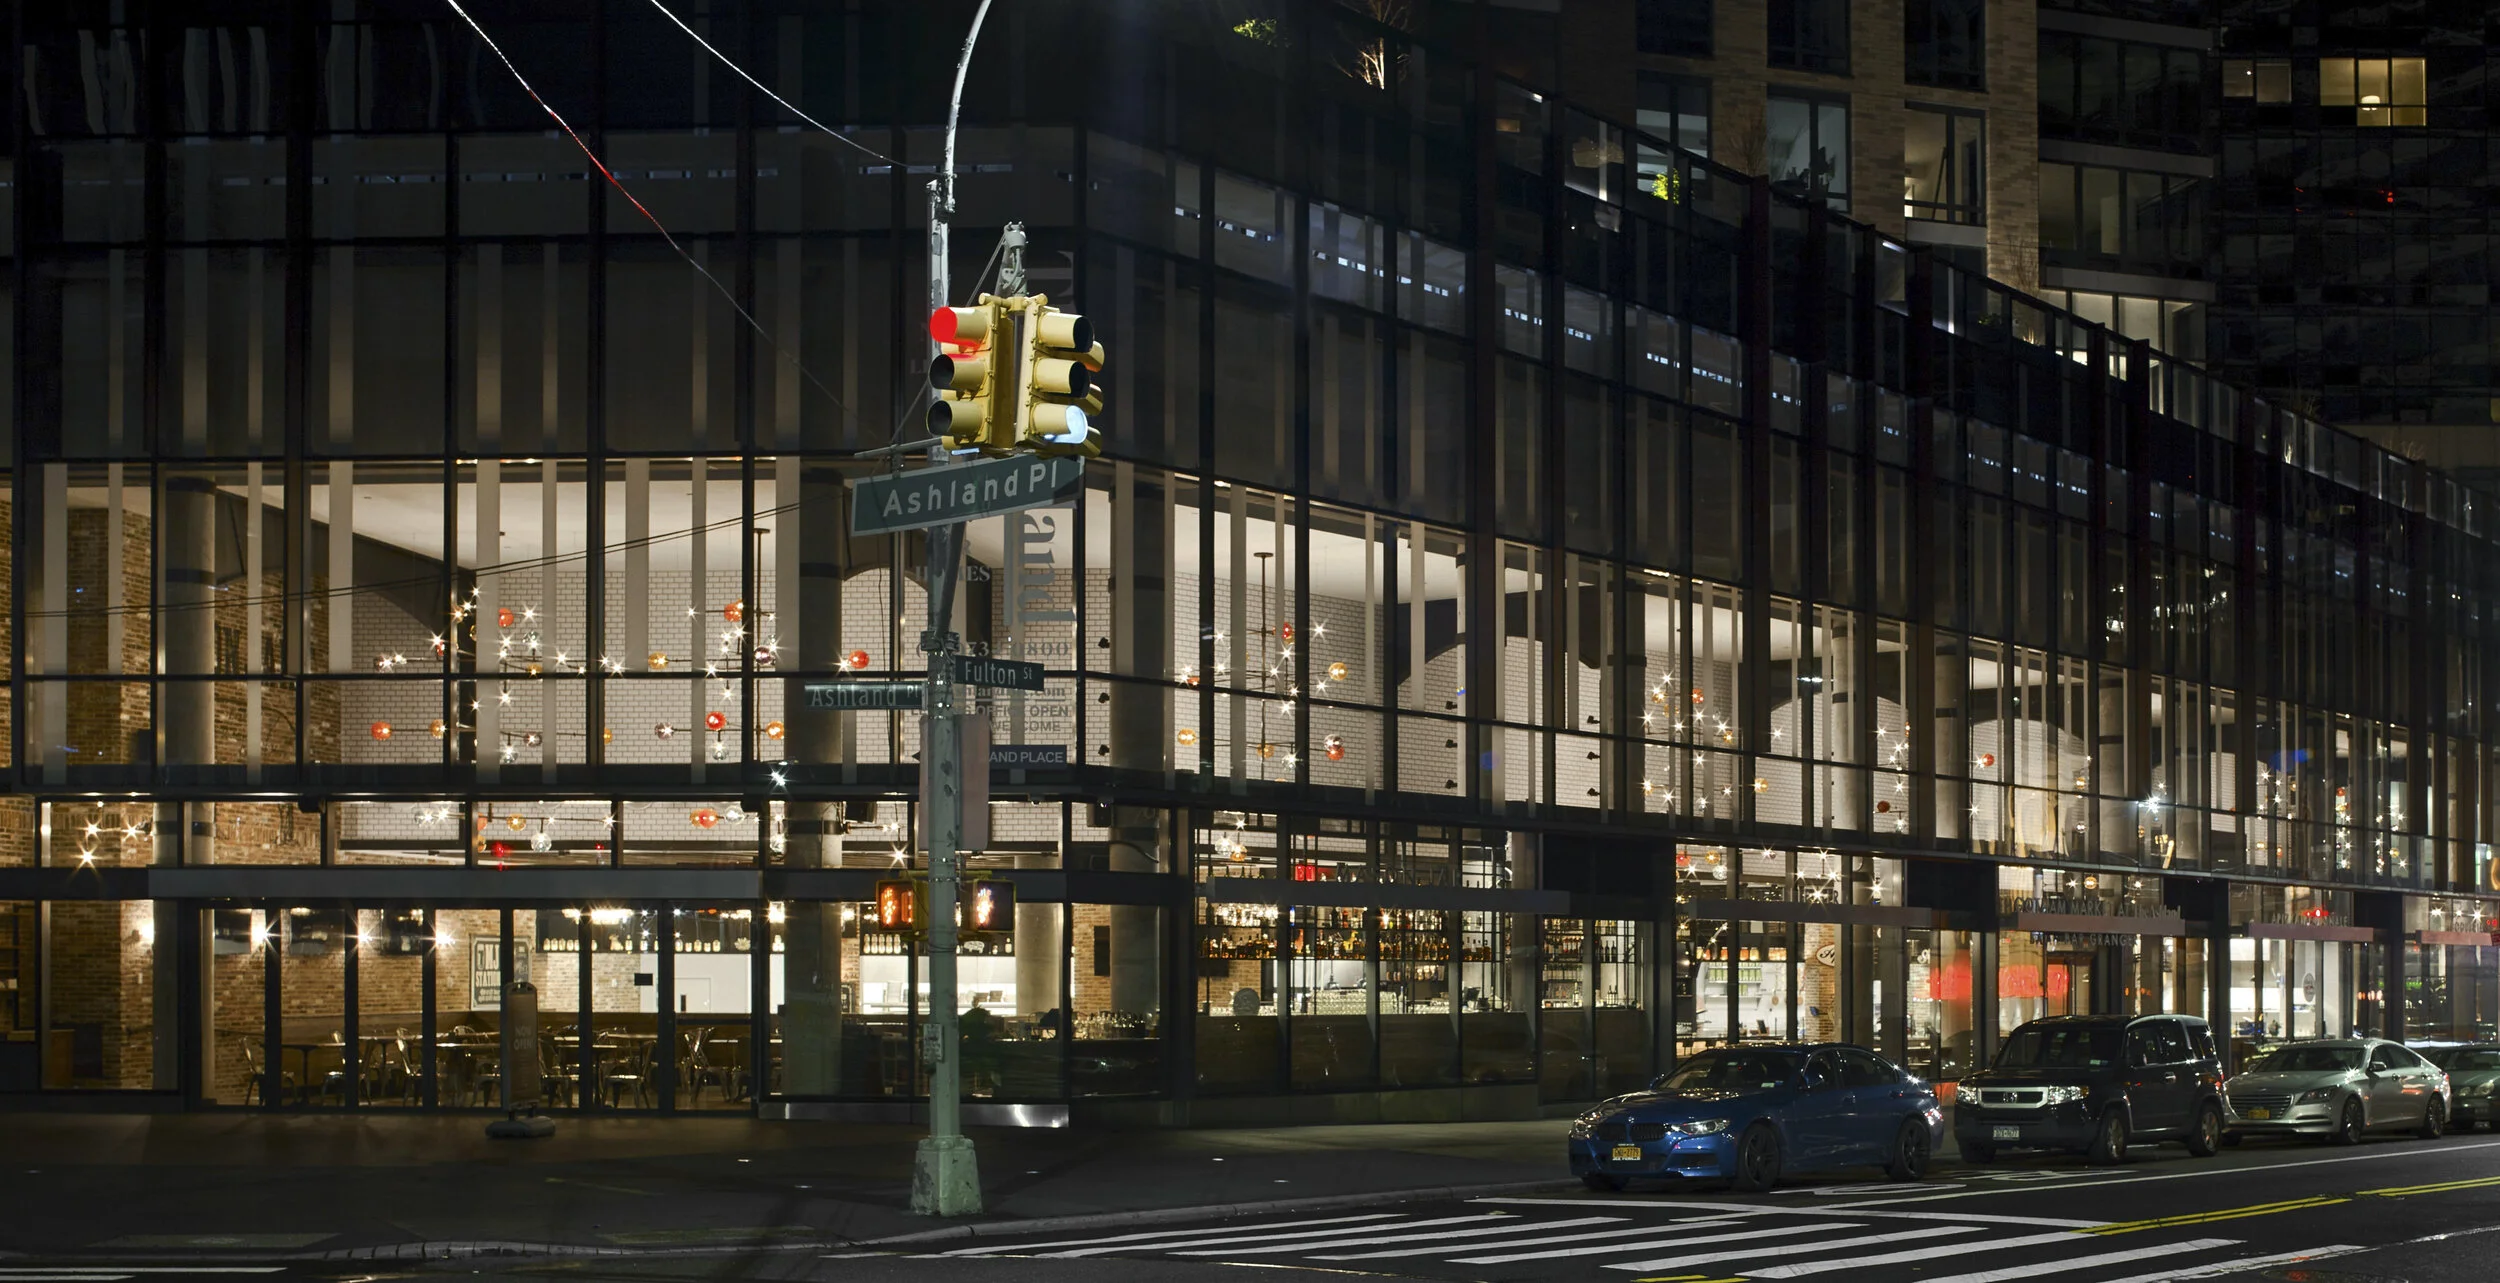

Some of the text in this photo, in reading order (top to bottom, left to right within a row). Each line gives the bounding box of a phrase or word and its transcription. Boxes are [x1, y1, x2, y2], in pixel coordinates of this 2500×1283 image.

[883, 460, 1057, 517] Ashland Pl
[965, 660, 1033, 686] Fulton St
[811, 684, 919, 707] Ashland Pl
[976, 705, 1024, 717] OFFI
[1029, 704, 1069, 717] OPEN
[989, 719, 1061, 733] WECOME
[1019, 751, 1065, 763] PLACE
